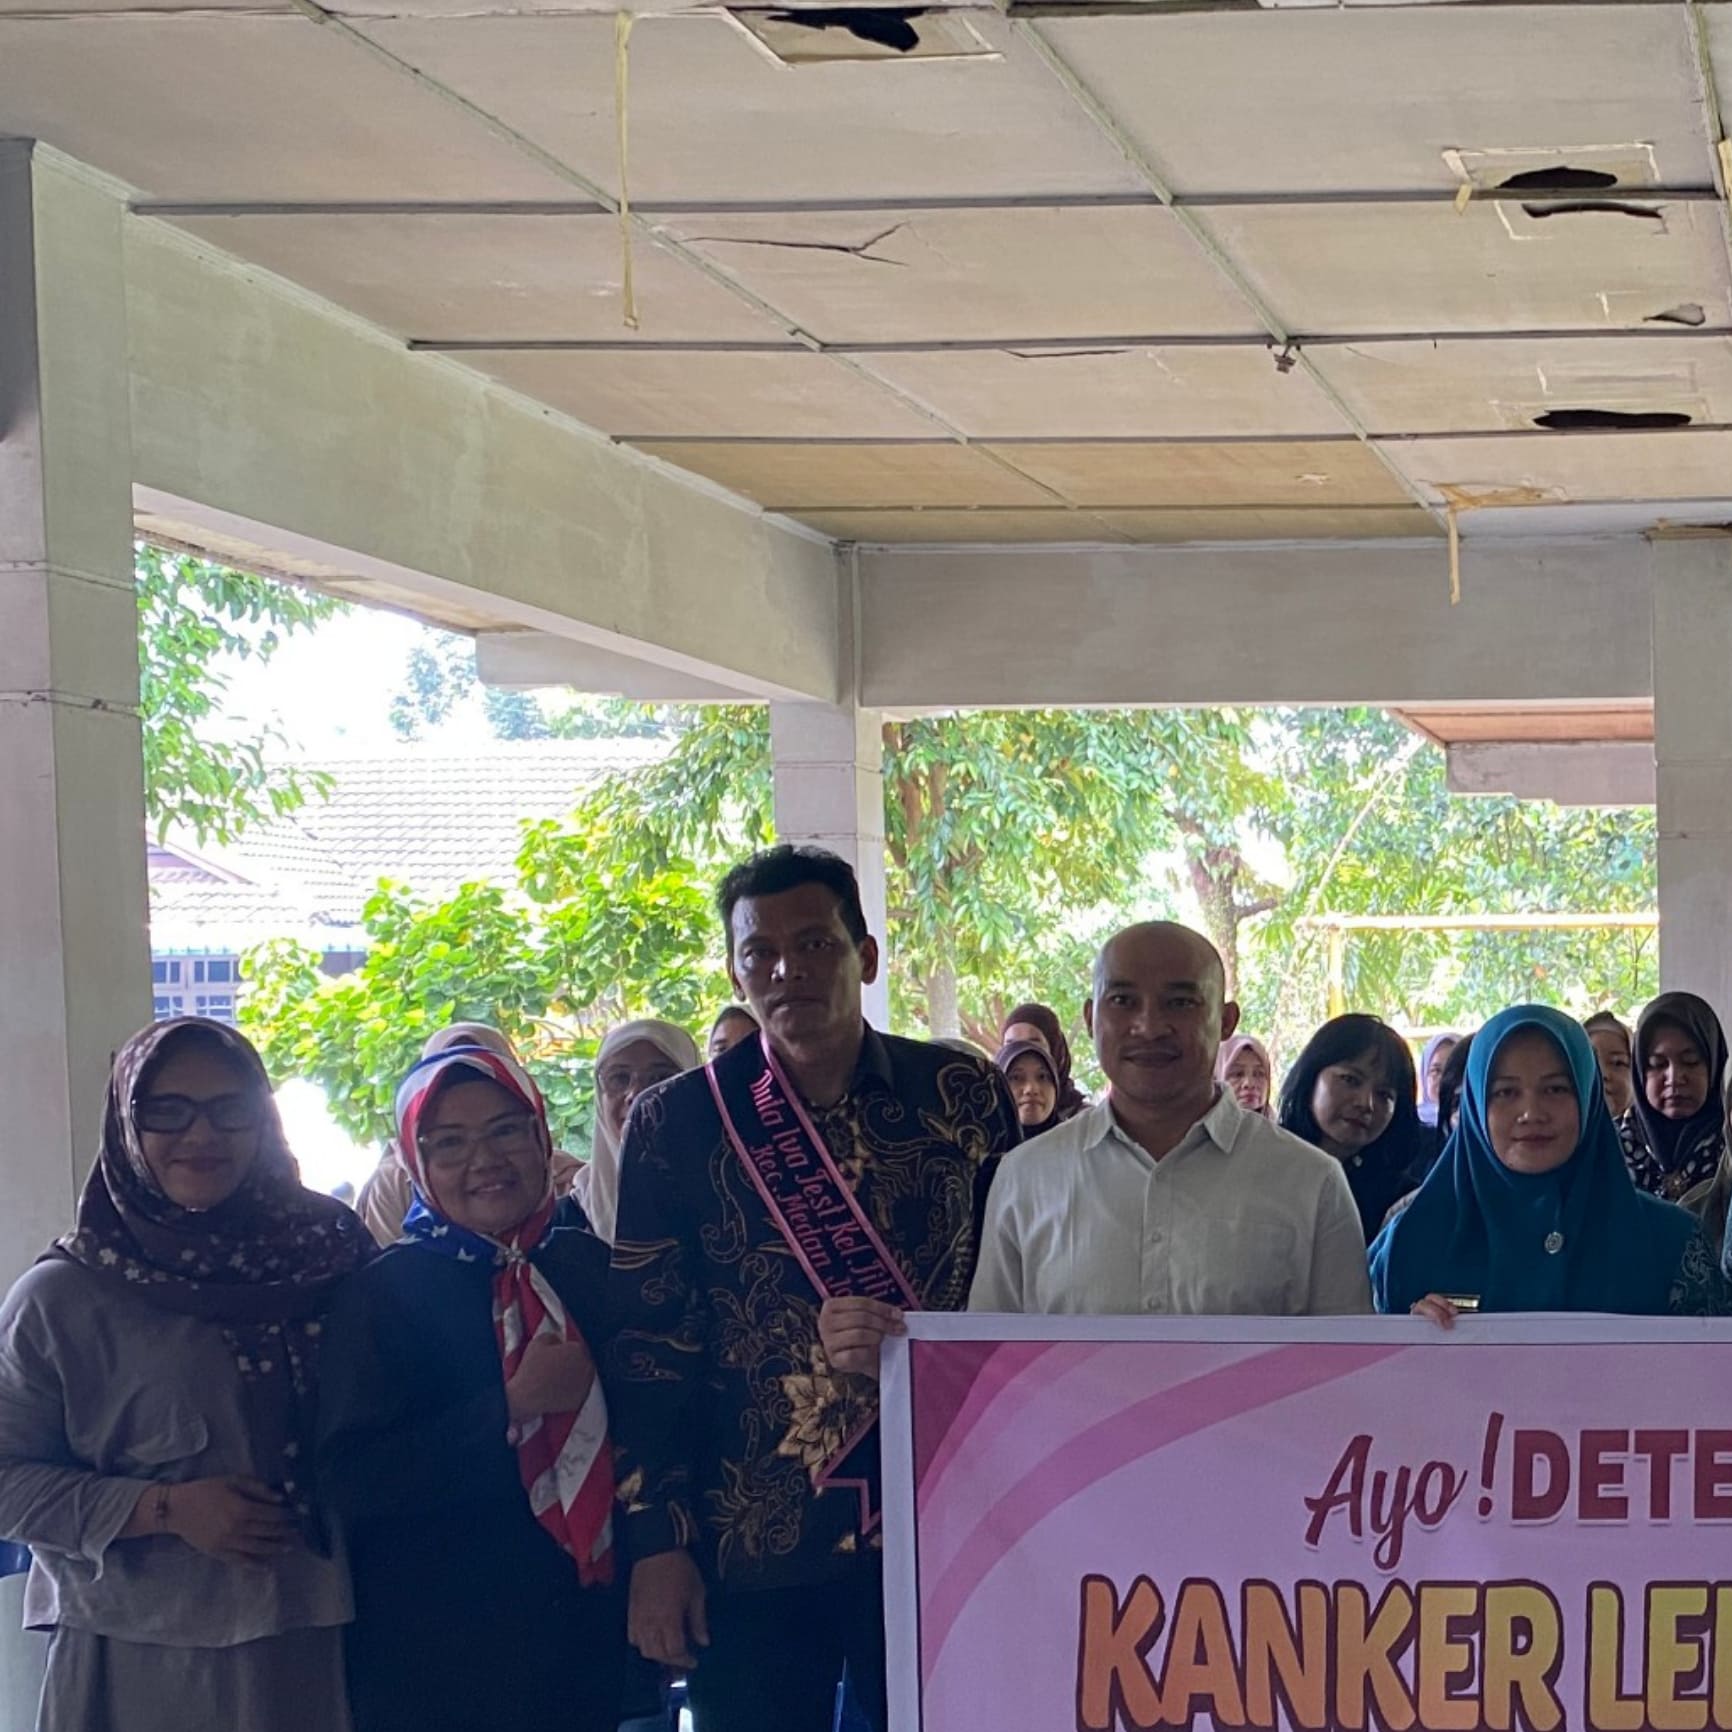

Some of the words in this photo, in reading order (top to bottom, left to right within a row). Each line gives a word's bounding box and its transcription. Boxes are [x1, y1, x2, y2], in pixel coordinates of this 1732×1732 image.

[772, 1127, 809, 1168] Iva
[794, 1167, 848, 1217] Test
[776, 1193, 832, 1268] Medan
[1304, 1411, 1504, 1569] Ayo!
